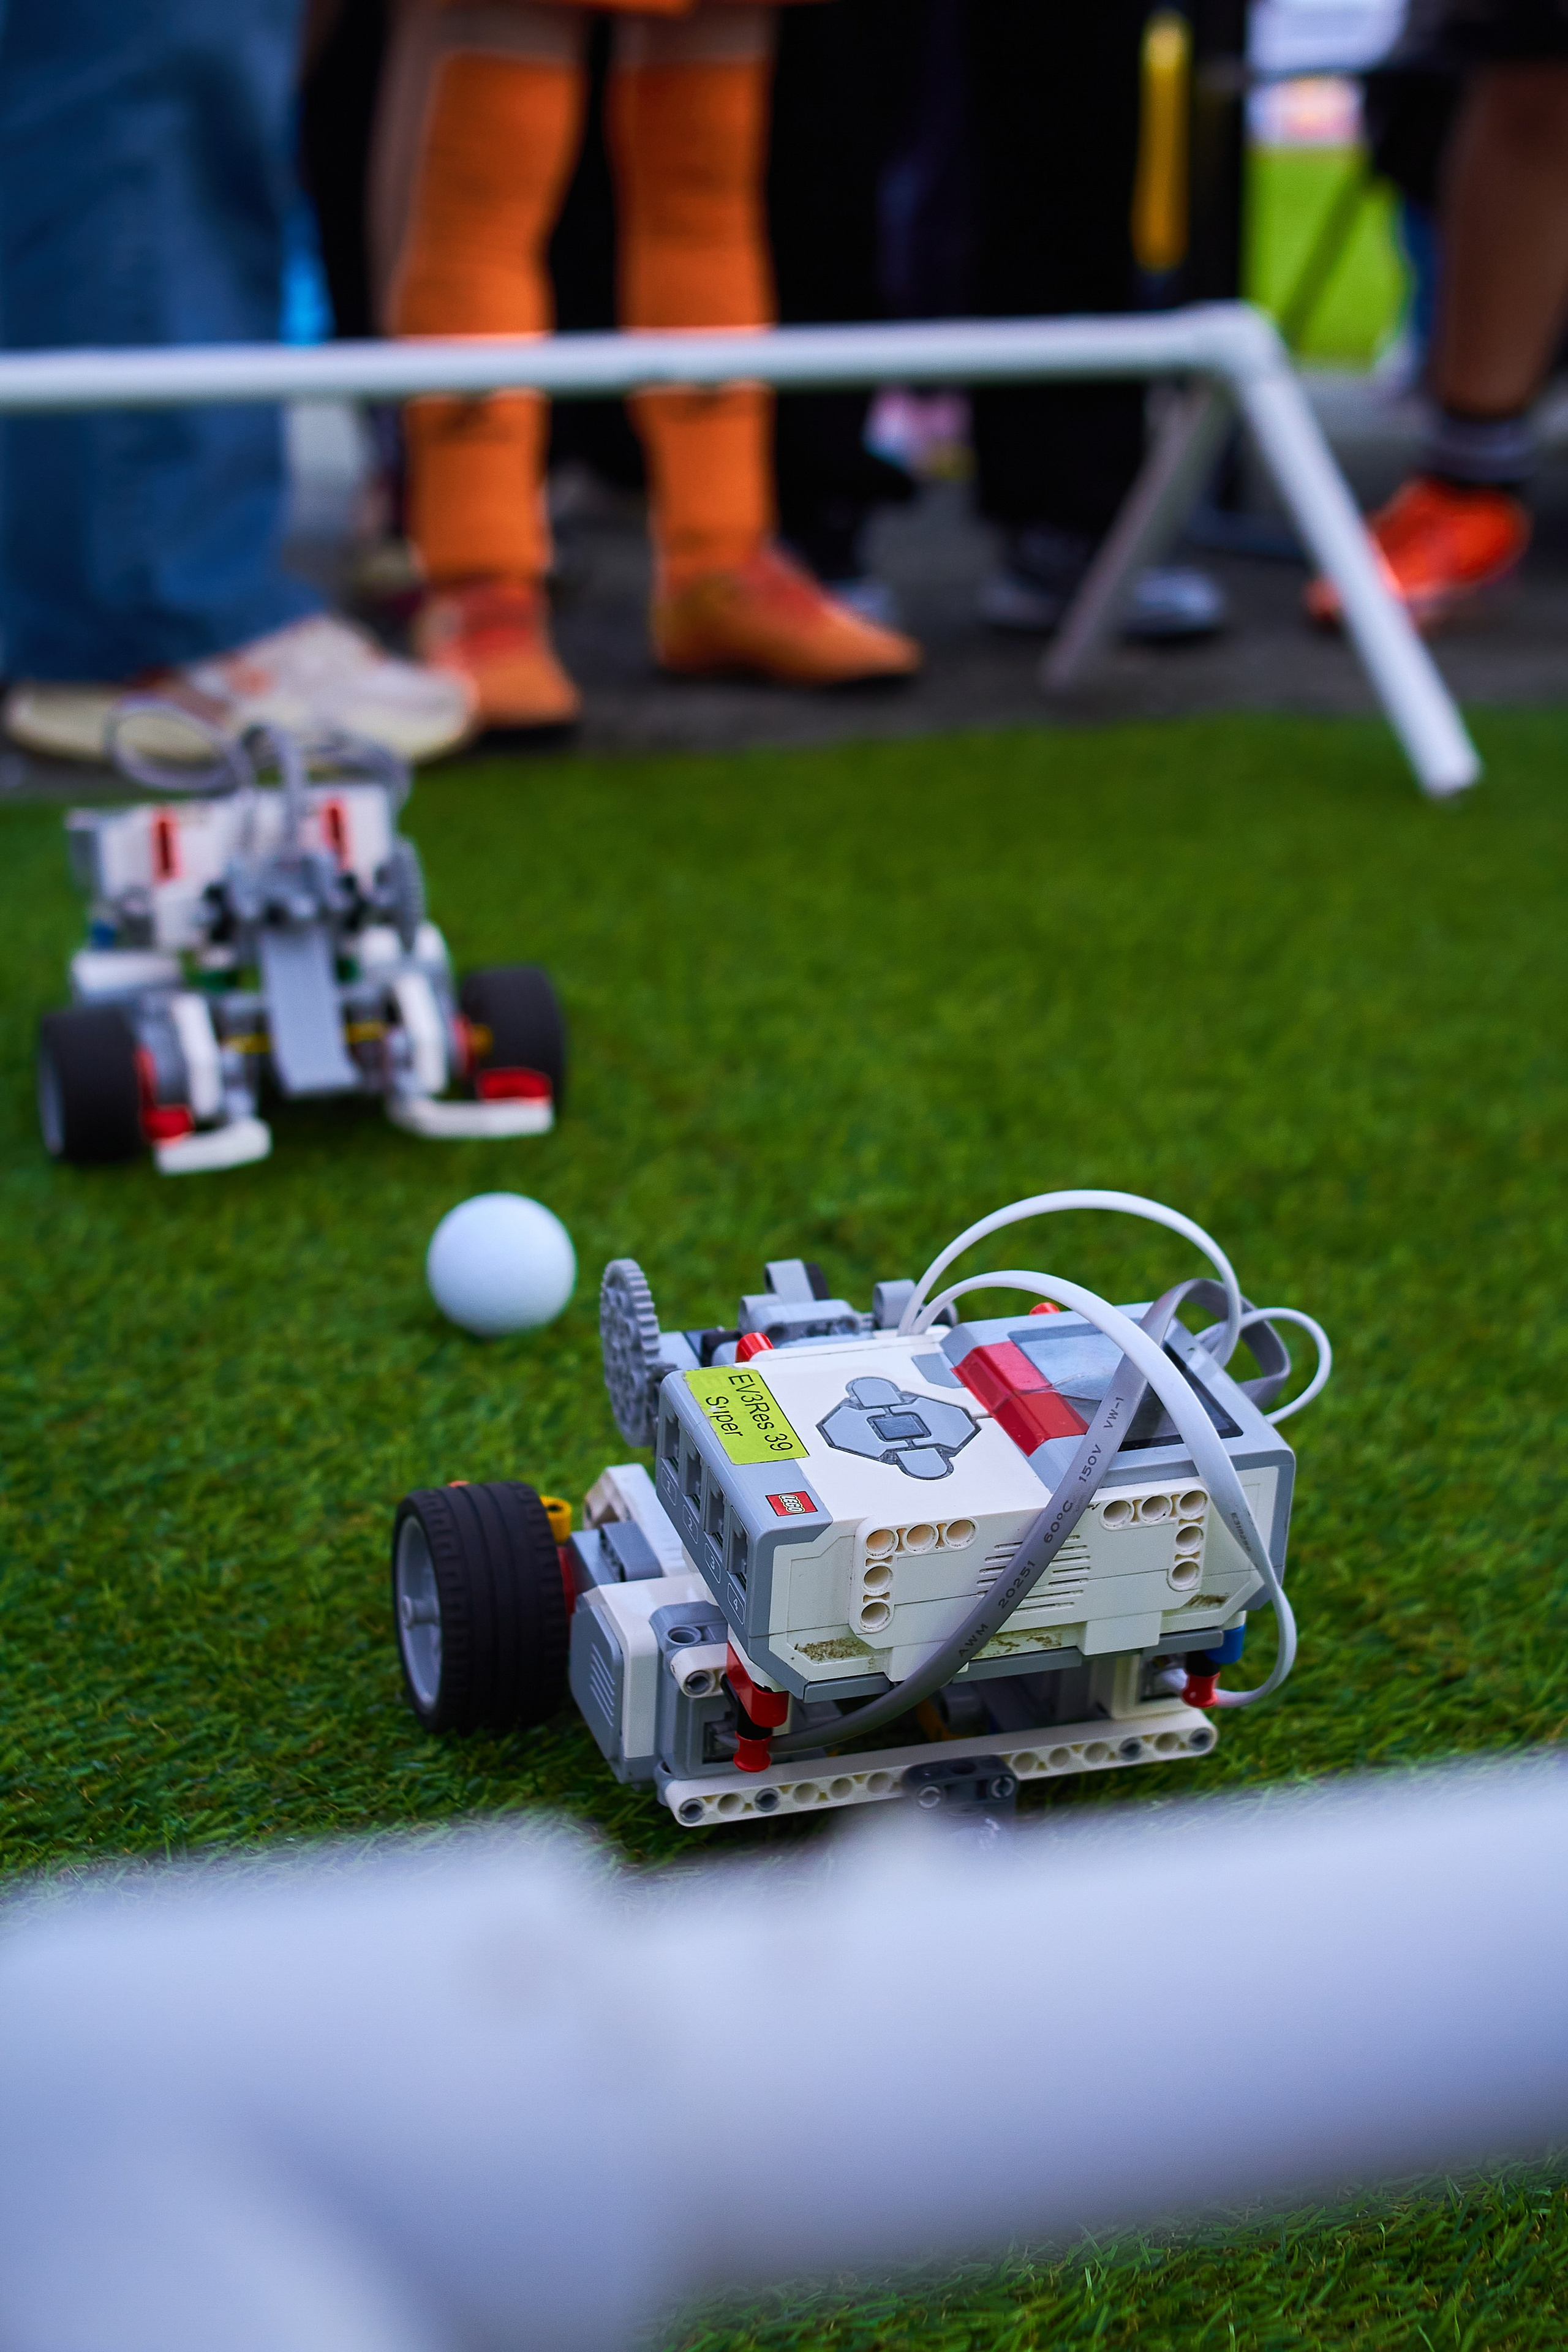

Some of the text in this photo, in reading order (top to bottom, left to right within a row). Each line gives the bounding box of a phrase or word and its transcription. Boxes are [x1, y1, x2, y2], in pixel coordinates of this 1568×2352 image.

[728, 1374, 793, 1452] EV3Res 39
[778, 1494, 805, 1513] LEGO
[959, 1623, 989, 1657] AWM
[998, 1560, 1036, 1609] 20251
[1079, 1444, 1102, 1482] 150V
[1103, 1396, 1125, 1429] VW-1
